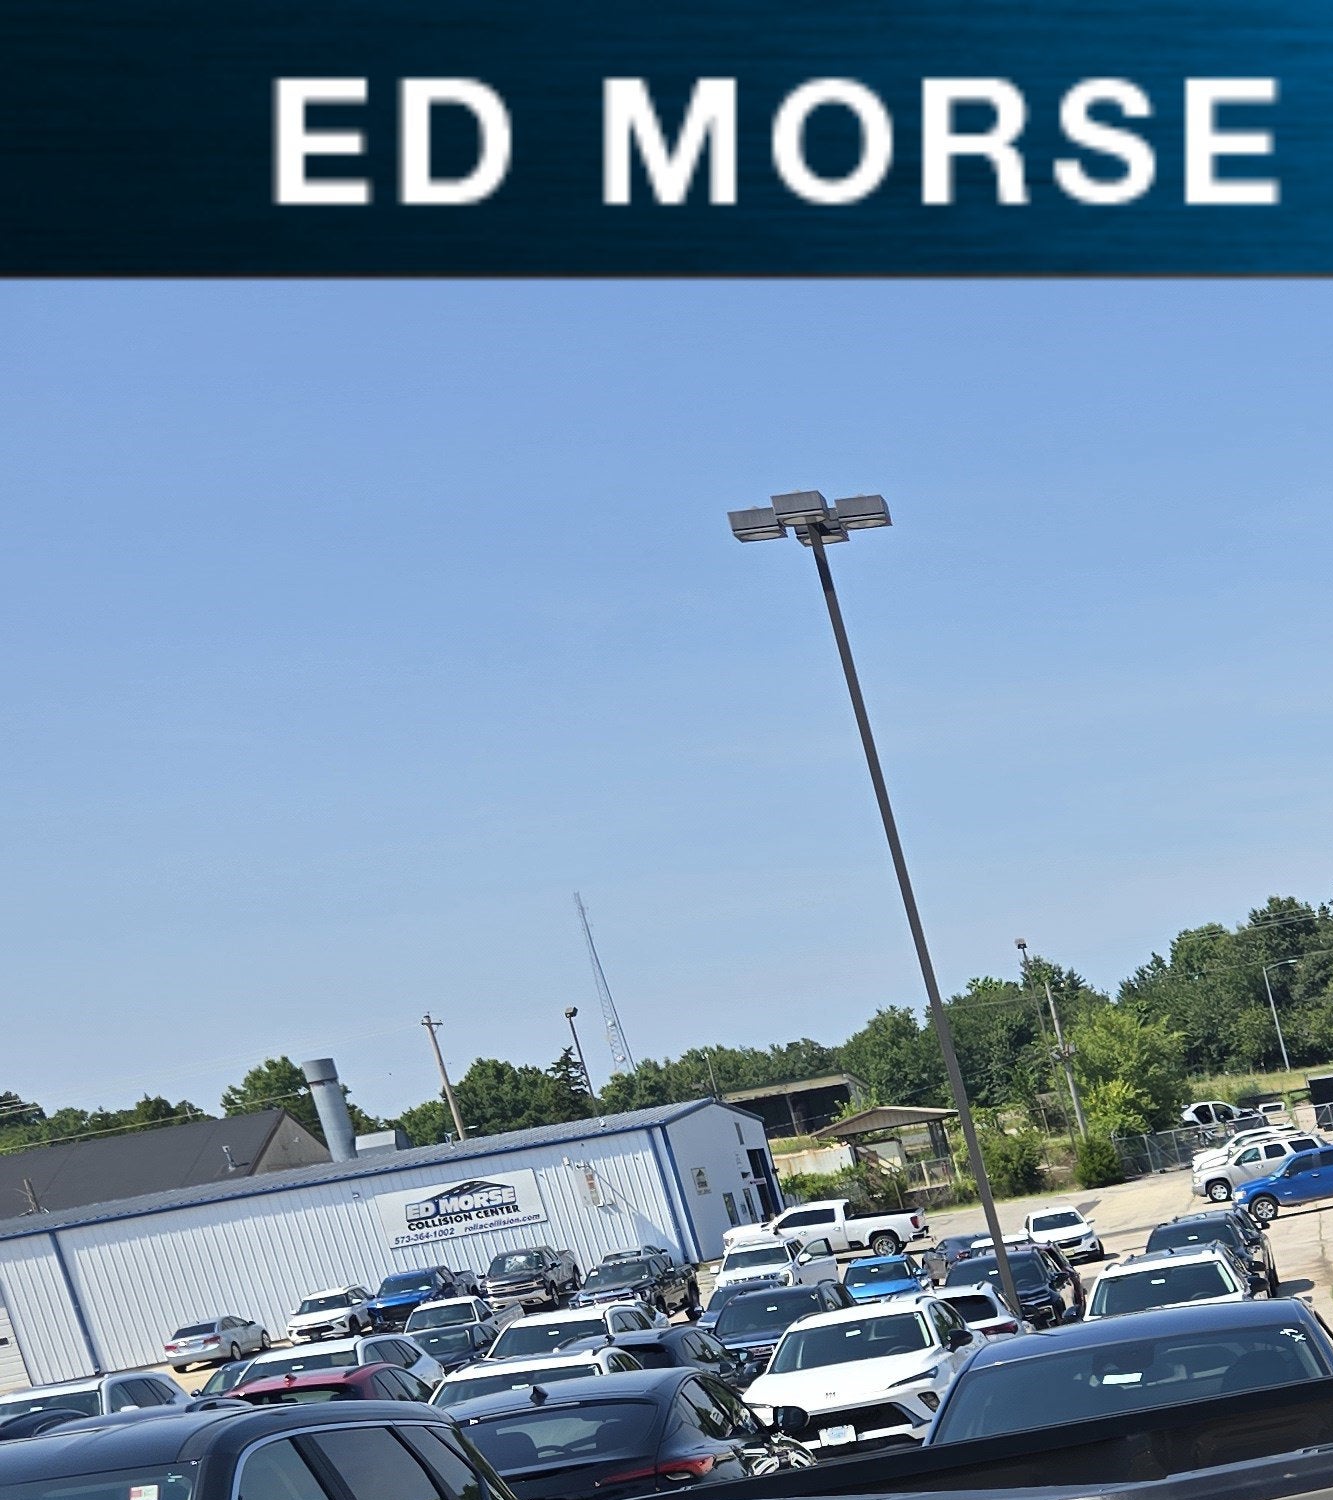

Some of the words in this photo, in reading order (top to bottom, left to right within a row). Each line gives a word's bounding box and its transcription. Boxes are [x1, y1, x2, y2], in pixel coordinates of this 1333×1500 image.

[405, 1202, 437, 1222] ED
[438, 1185, 517, 1216] MORSE
[407, 1211, 473, 1232] COLLISION
[475, 1204, 521, 1219] CENTER
[464, 1213, 541, 1233] rollacollision.com
[394, 1227, 455, 1245] 573-364-1002
